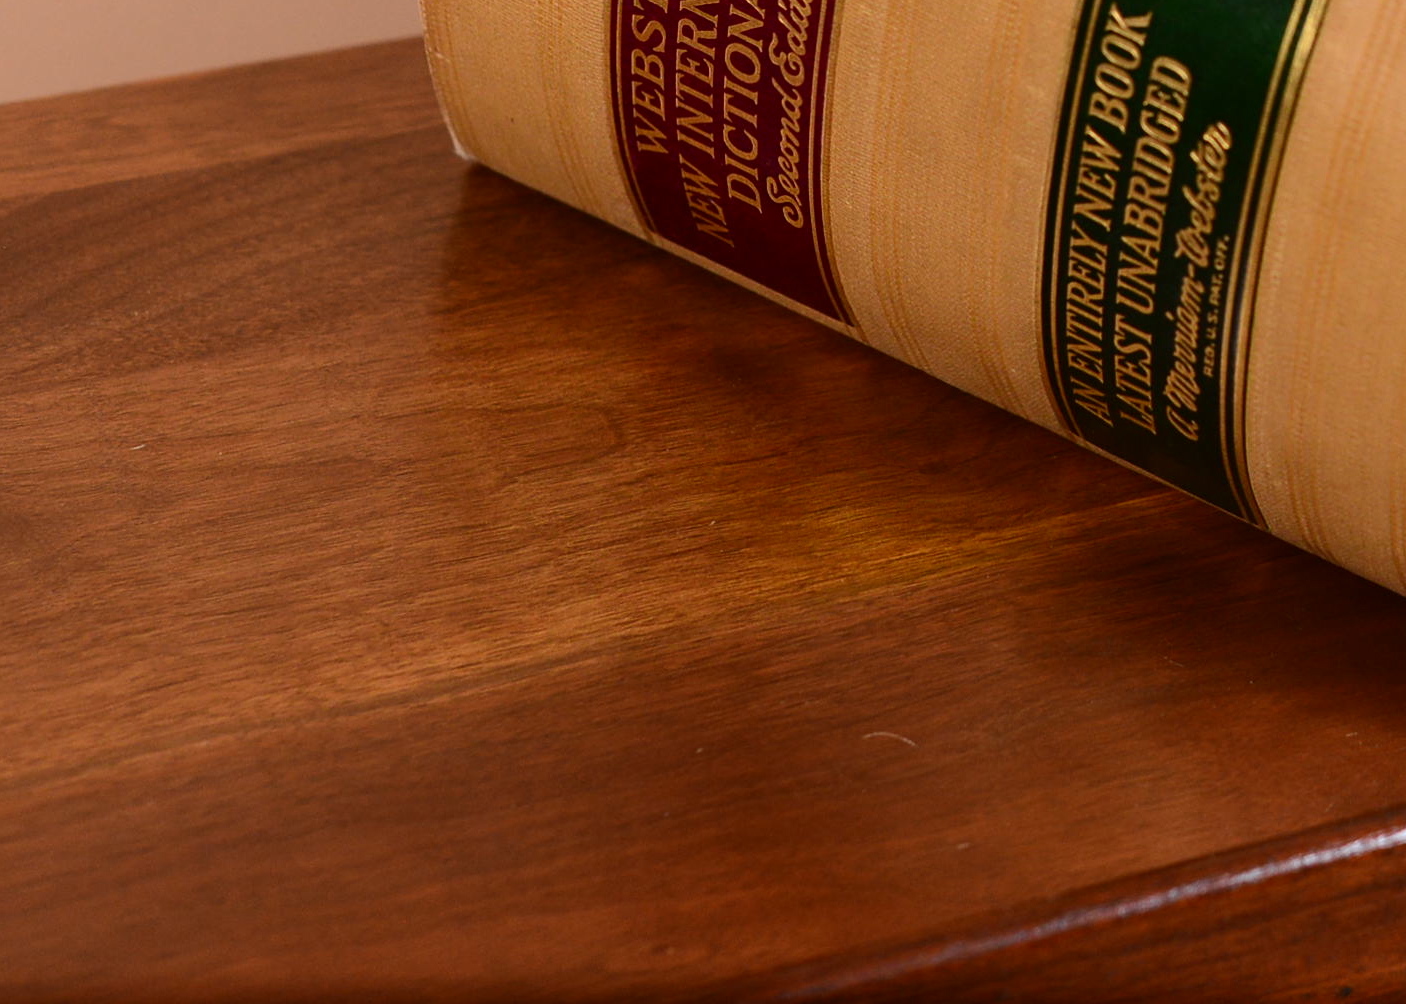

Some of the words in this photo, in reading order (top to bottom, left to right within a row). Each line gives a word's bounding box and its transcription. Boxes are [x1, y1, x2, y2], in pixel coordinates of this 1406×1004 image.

[1089, 2, 1153, 134] BOOK
[679, 154, 734, 247] NEW
[767, 77, 804, 228] Second
[1073, 124, 1122, 232] NEW
[1115, 56, 1192, 314] UNABRIDGED
[1066, 219, 1108, 384] ENTIRELY
[1163, 121, 1232, 412] Merriam-Webster
[1209, 274, 1224, 306] PAT.
[1070, 377, 1114, 428] AN
[1114, 314, 1157, 435] LATEST
[1203, 343, 1216, 377] REG.
